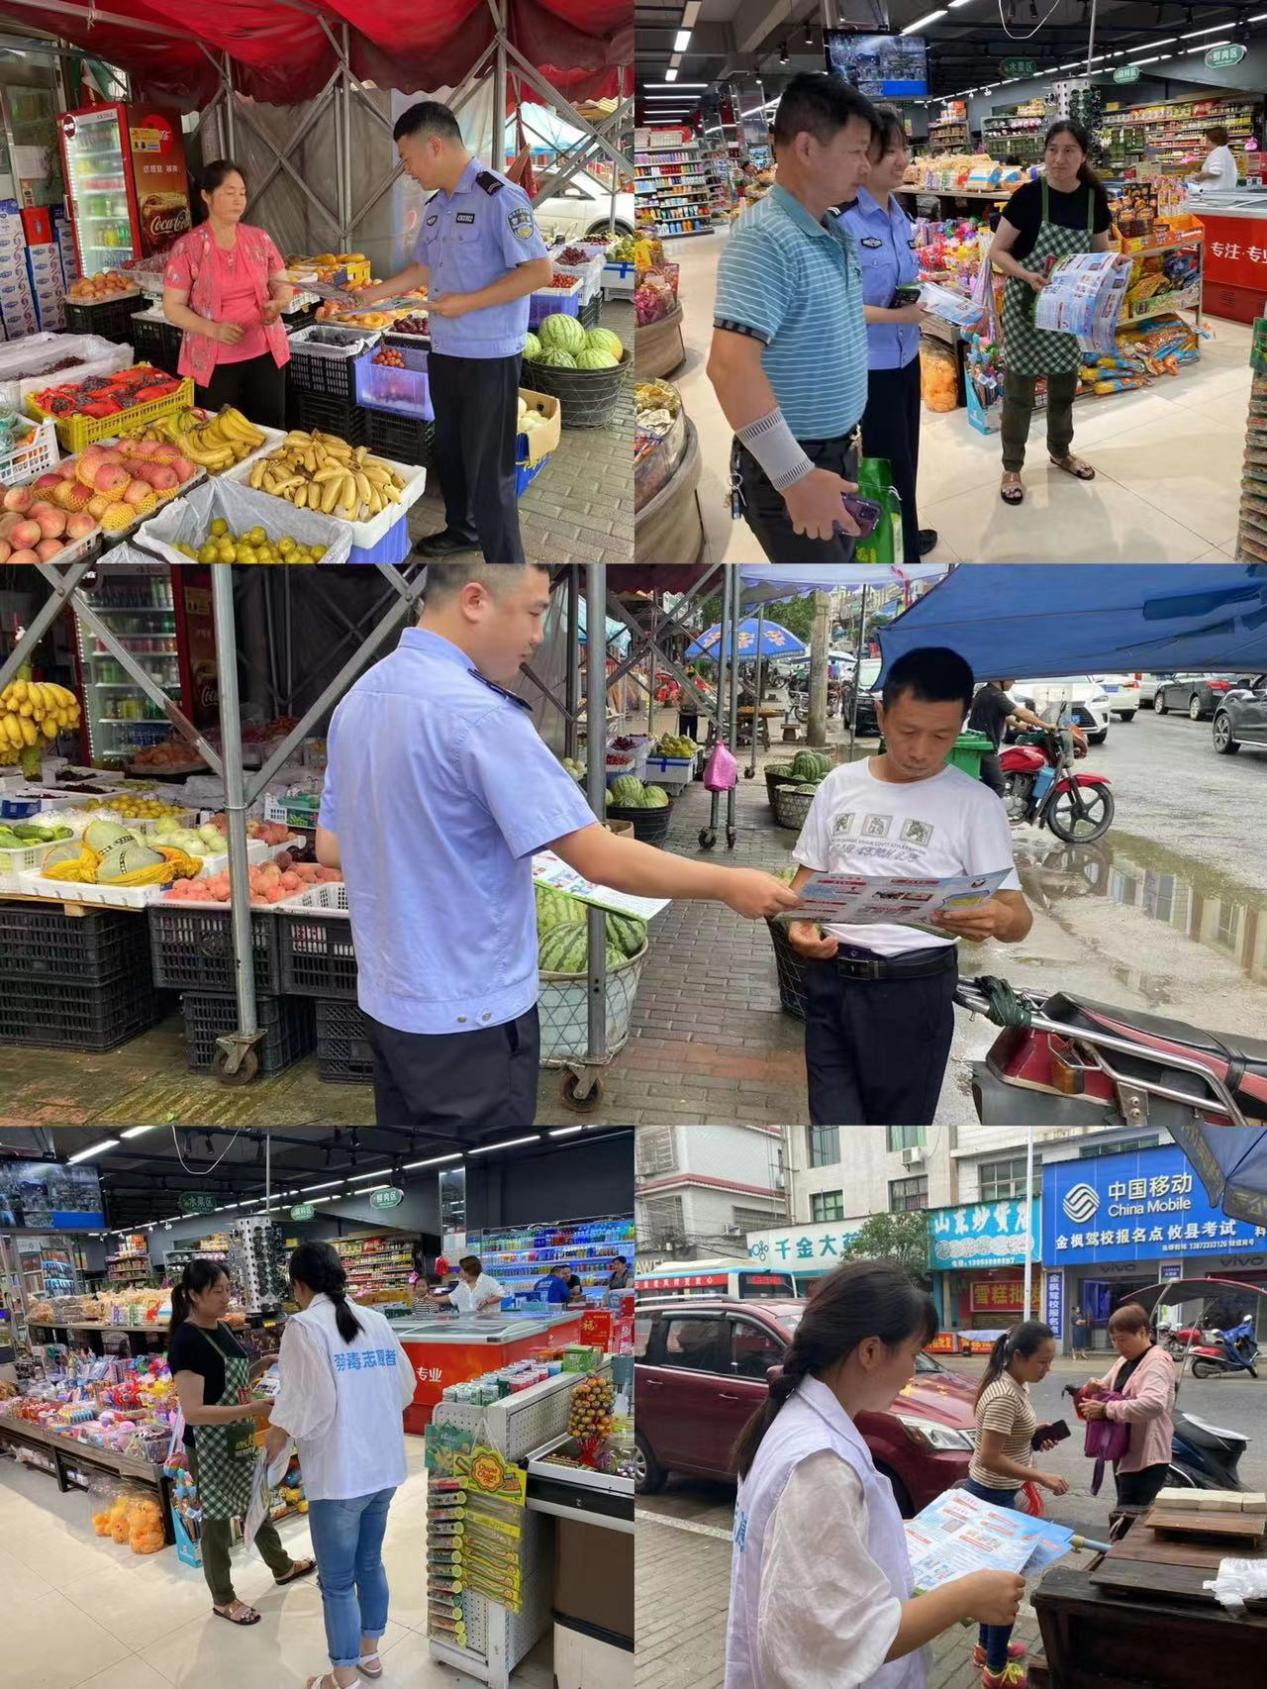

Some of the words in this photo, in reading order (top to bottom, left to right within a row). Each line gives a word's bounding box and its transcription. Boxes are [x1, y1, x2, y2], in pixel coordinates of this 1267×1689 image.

[1108, 1172, 1193, 1201] 中国移动
[1108, 1203, 1144, 1218] China
[1147, 1197, 1192, 1213] Mobile
[1055, 1226, 1163, 1250] 金枫驾校报名点
[1168, 1219, 1237, 1241] 攸县考试
[1100, 1262, 1137, 1273] vivo
[1219, 1255, 1264, 1269] vivo
[416, 1366, 442, 1383] 专业
